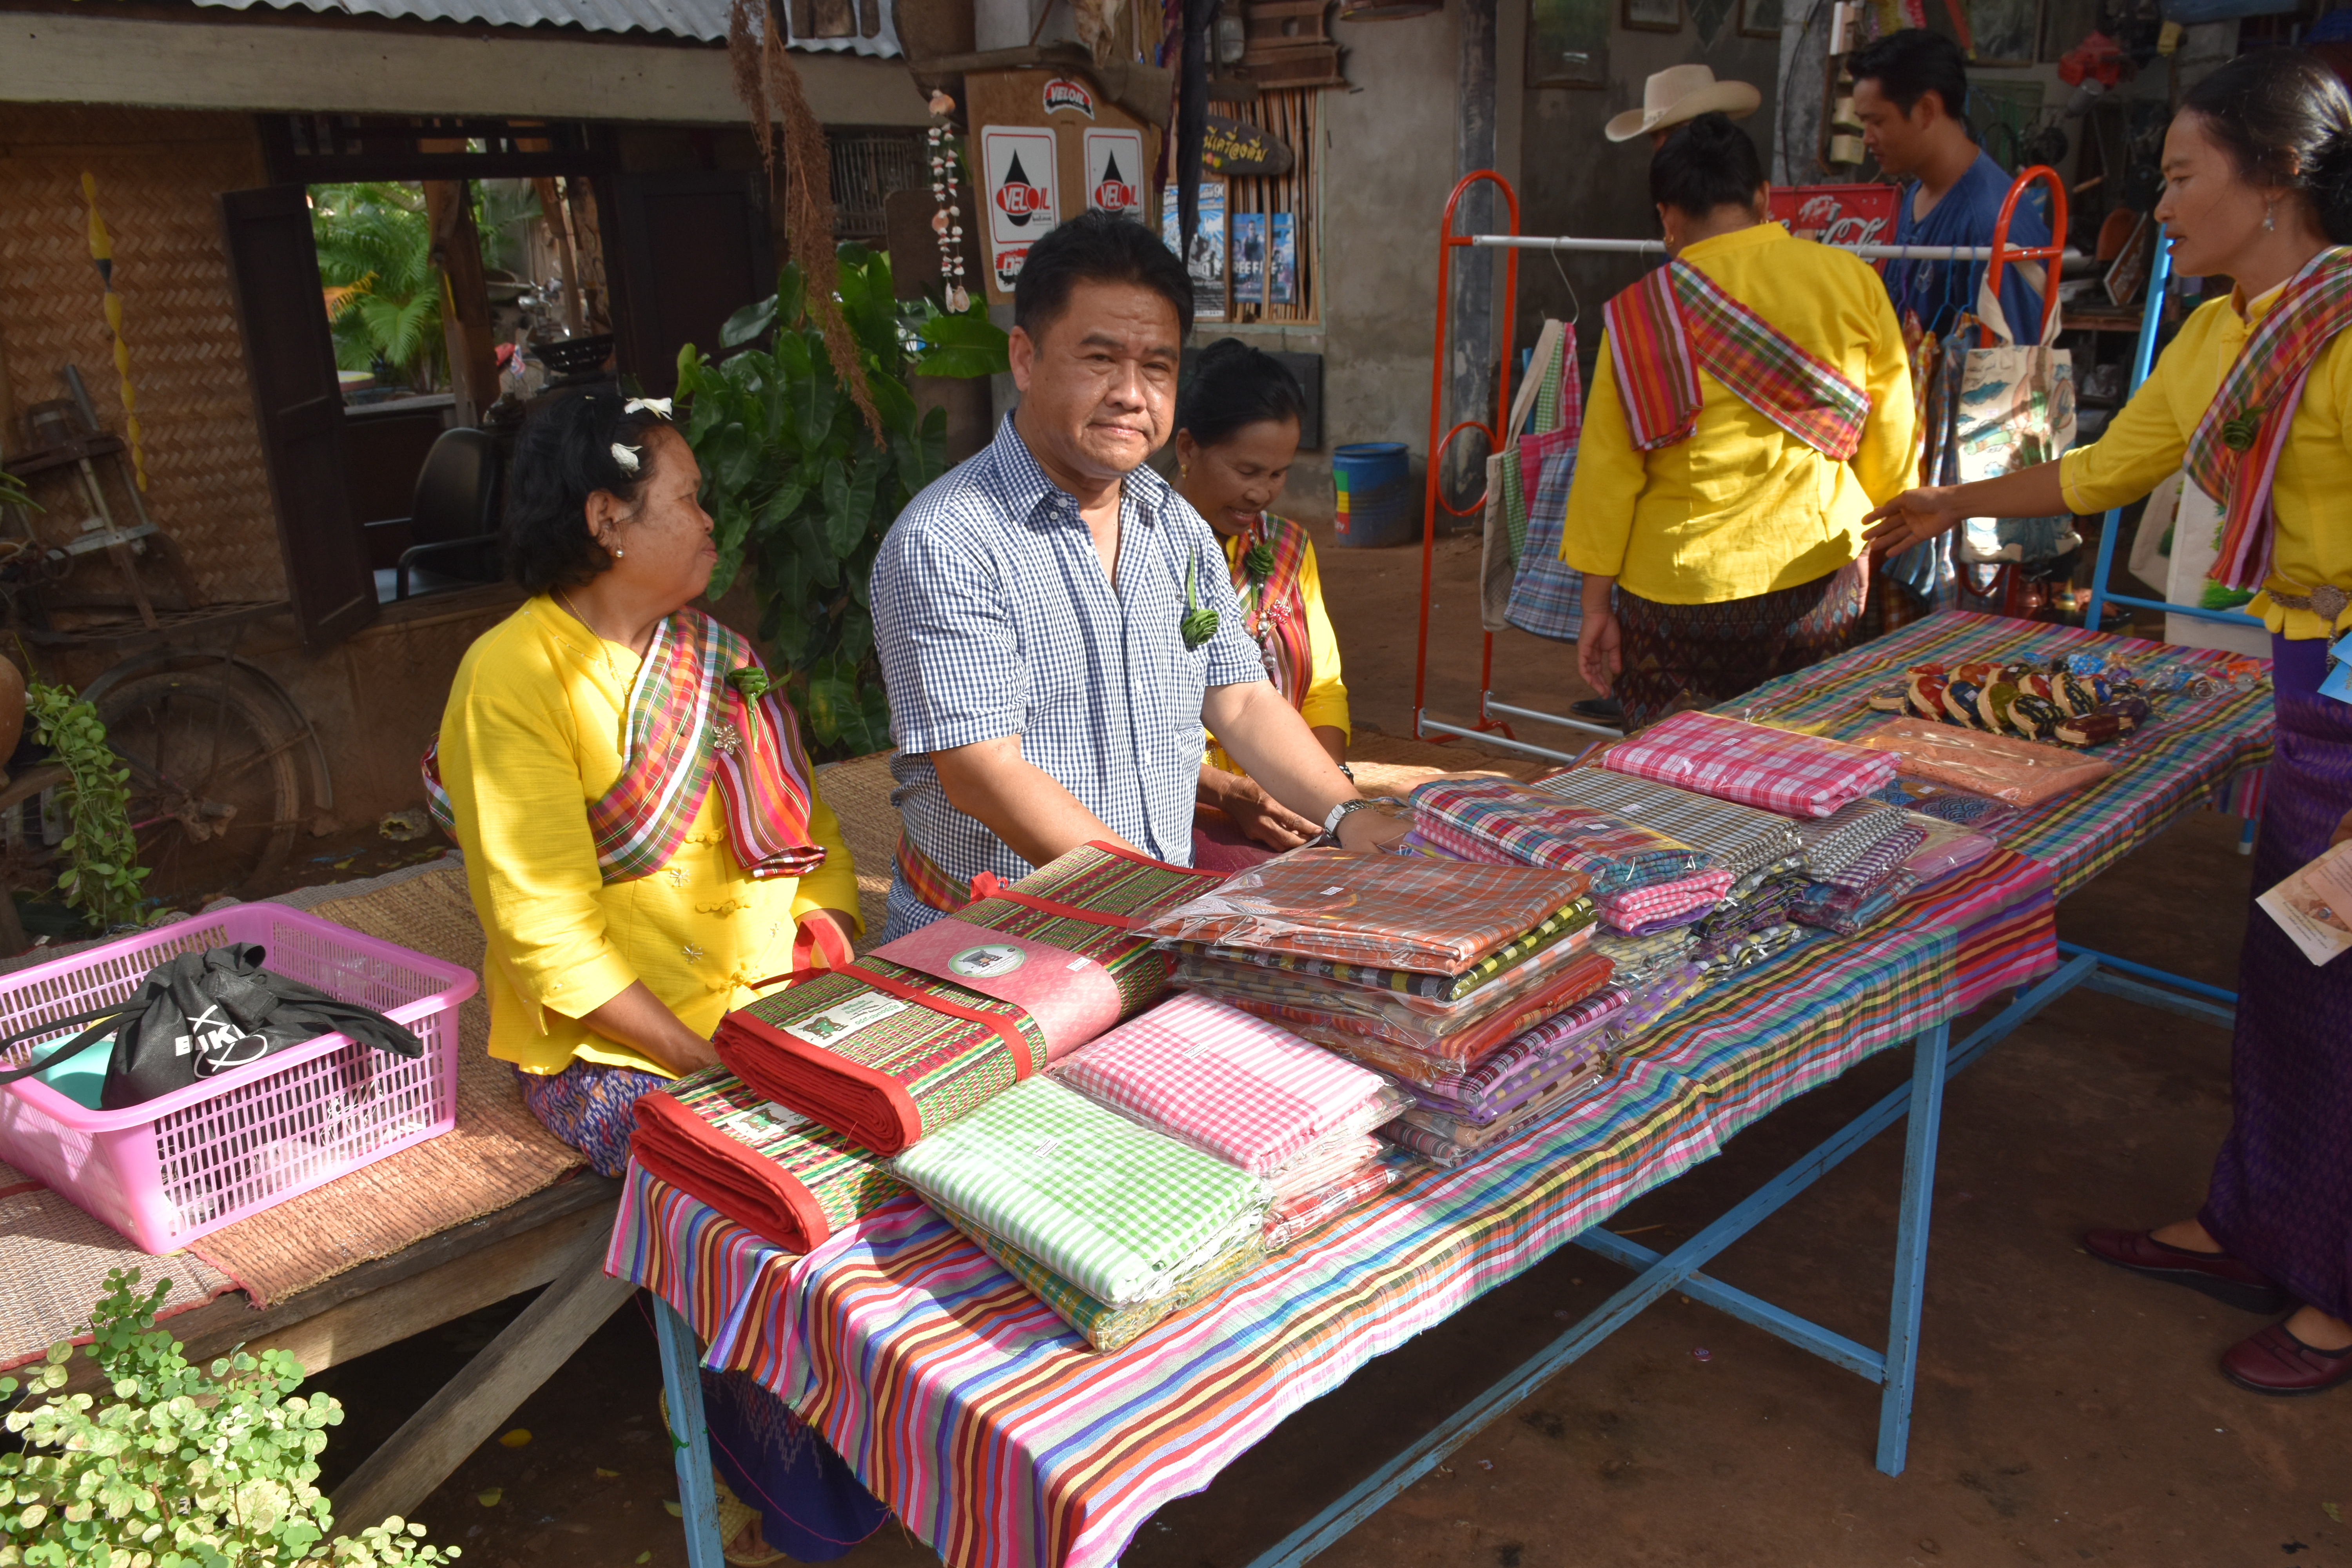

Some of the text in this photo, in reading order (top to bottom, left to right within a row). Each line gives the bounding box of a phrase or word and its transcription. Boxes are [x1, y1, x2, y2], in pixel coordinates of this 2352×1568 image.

[1051, 86, 1084, 105] VELOIL
[1002, 186, 1051, 211] VELOIL
[1100, 185, 1138, 207] VELOIL
